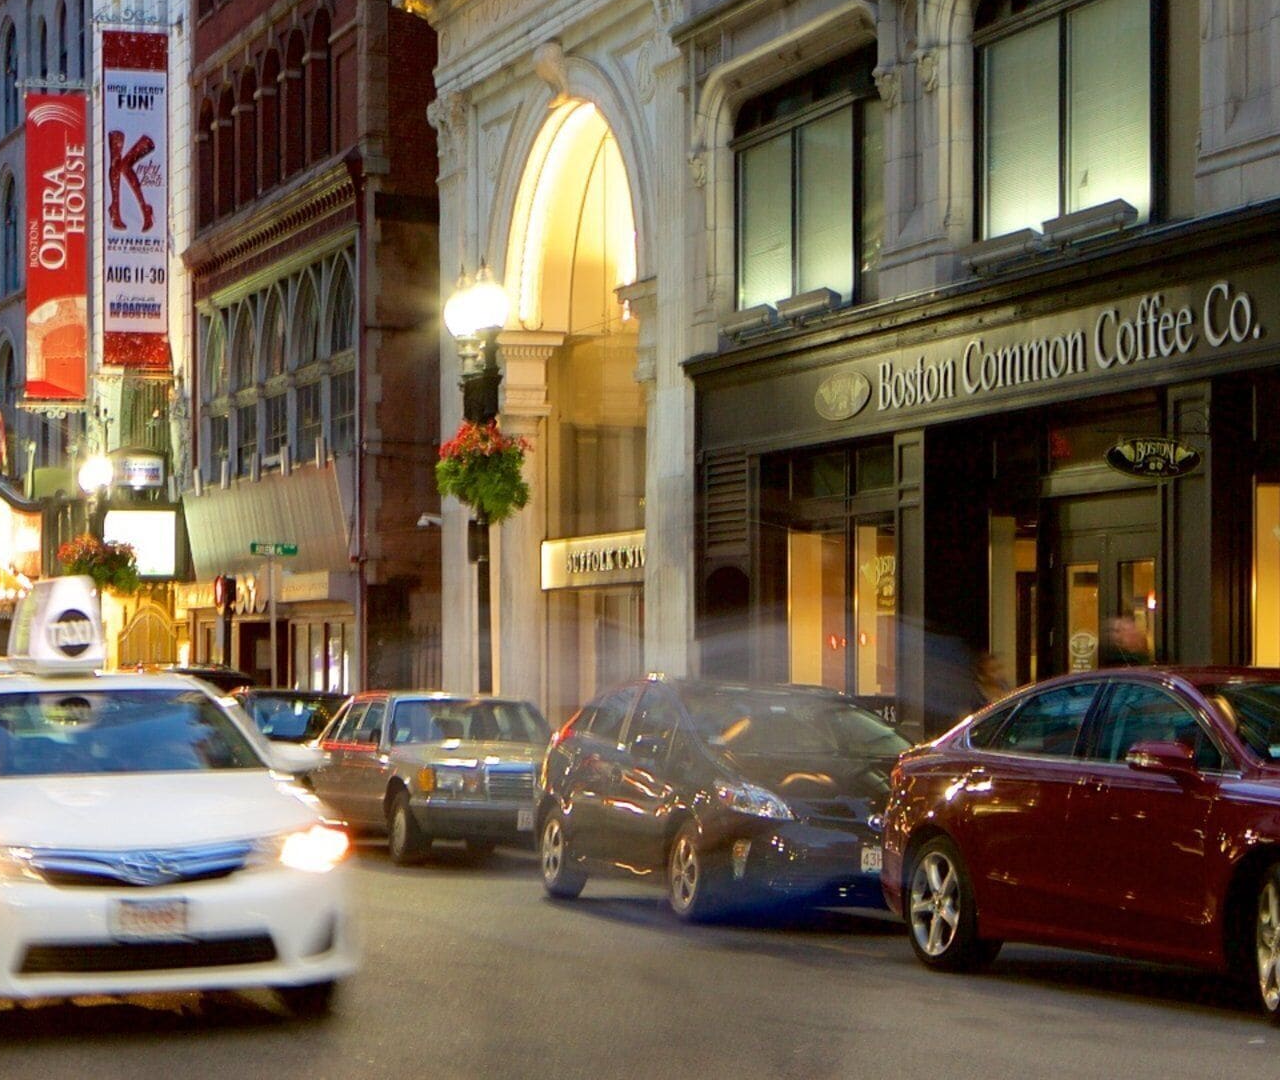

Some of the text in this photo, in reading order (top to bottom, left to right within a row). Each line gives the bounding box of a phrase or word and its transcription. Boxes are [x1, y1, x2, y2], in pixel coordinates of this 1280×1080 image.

[118, 93, 154, 110] FUN!
[66, 143, 86, 234] HOUSE
[39, 165, 65, 270] OPERA
[30, 220, 39, 267] BOSTON
[107, 266, 165, 284] AUG 11-30
[877, 357, 956, 411] Boston
[962, 332, 1087, 395] Common
[1094, 292, 1194, 370] Coffee
[1203, 280, 1261, 348] Co.
[1136, 442, 1174, 465] BOSTON
[566, 547, 614, 573] SUFFOLK
[48, 621, 93, 646] TAXI
